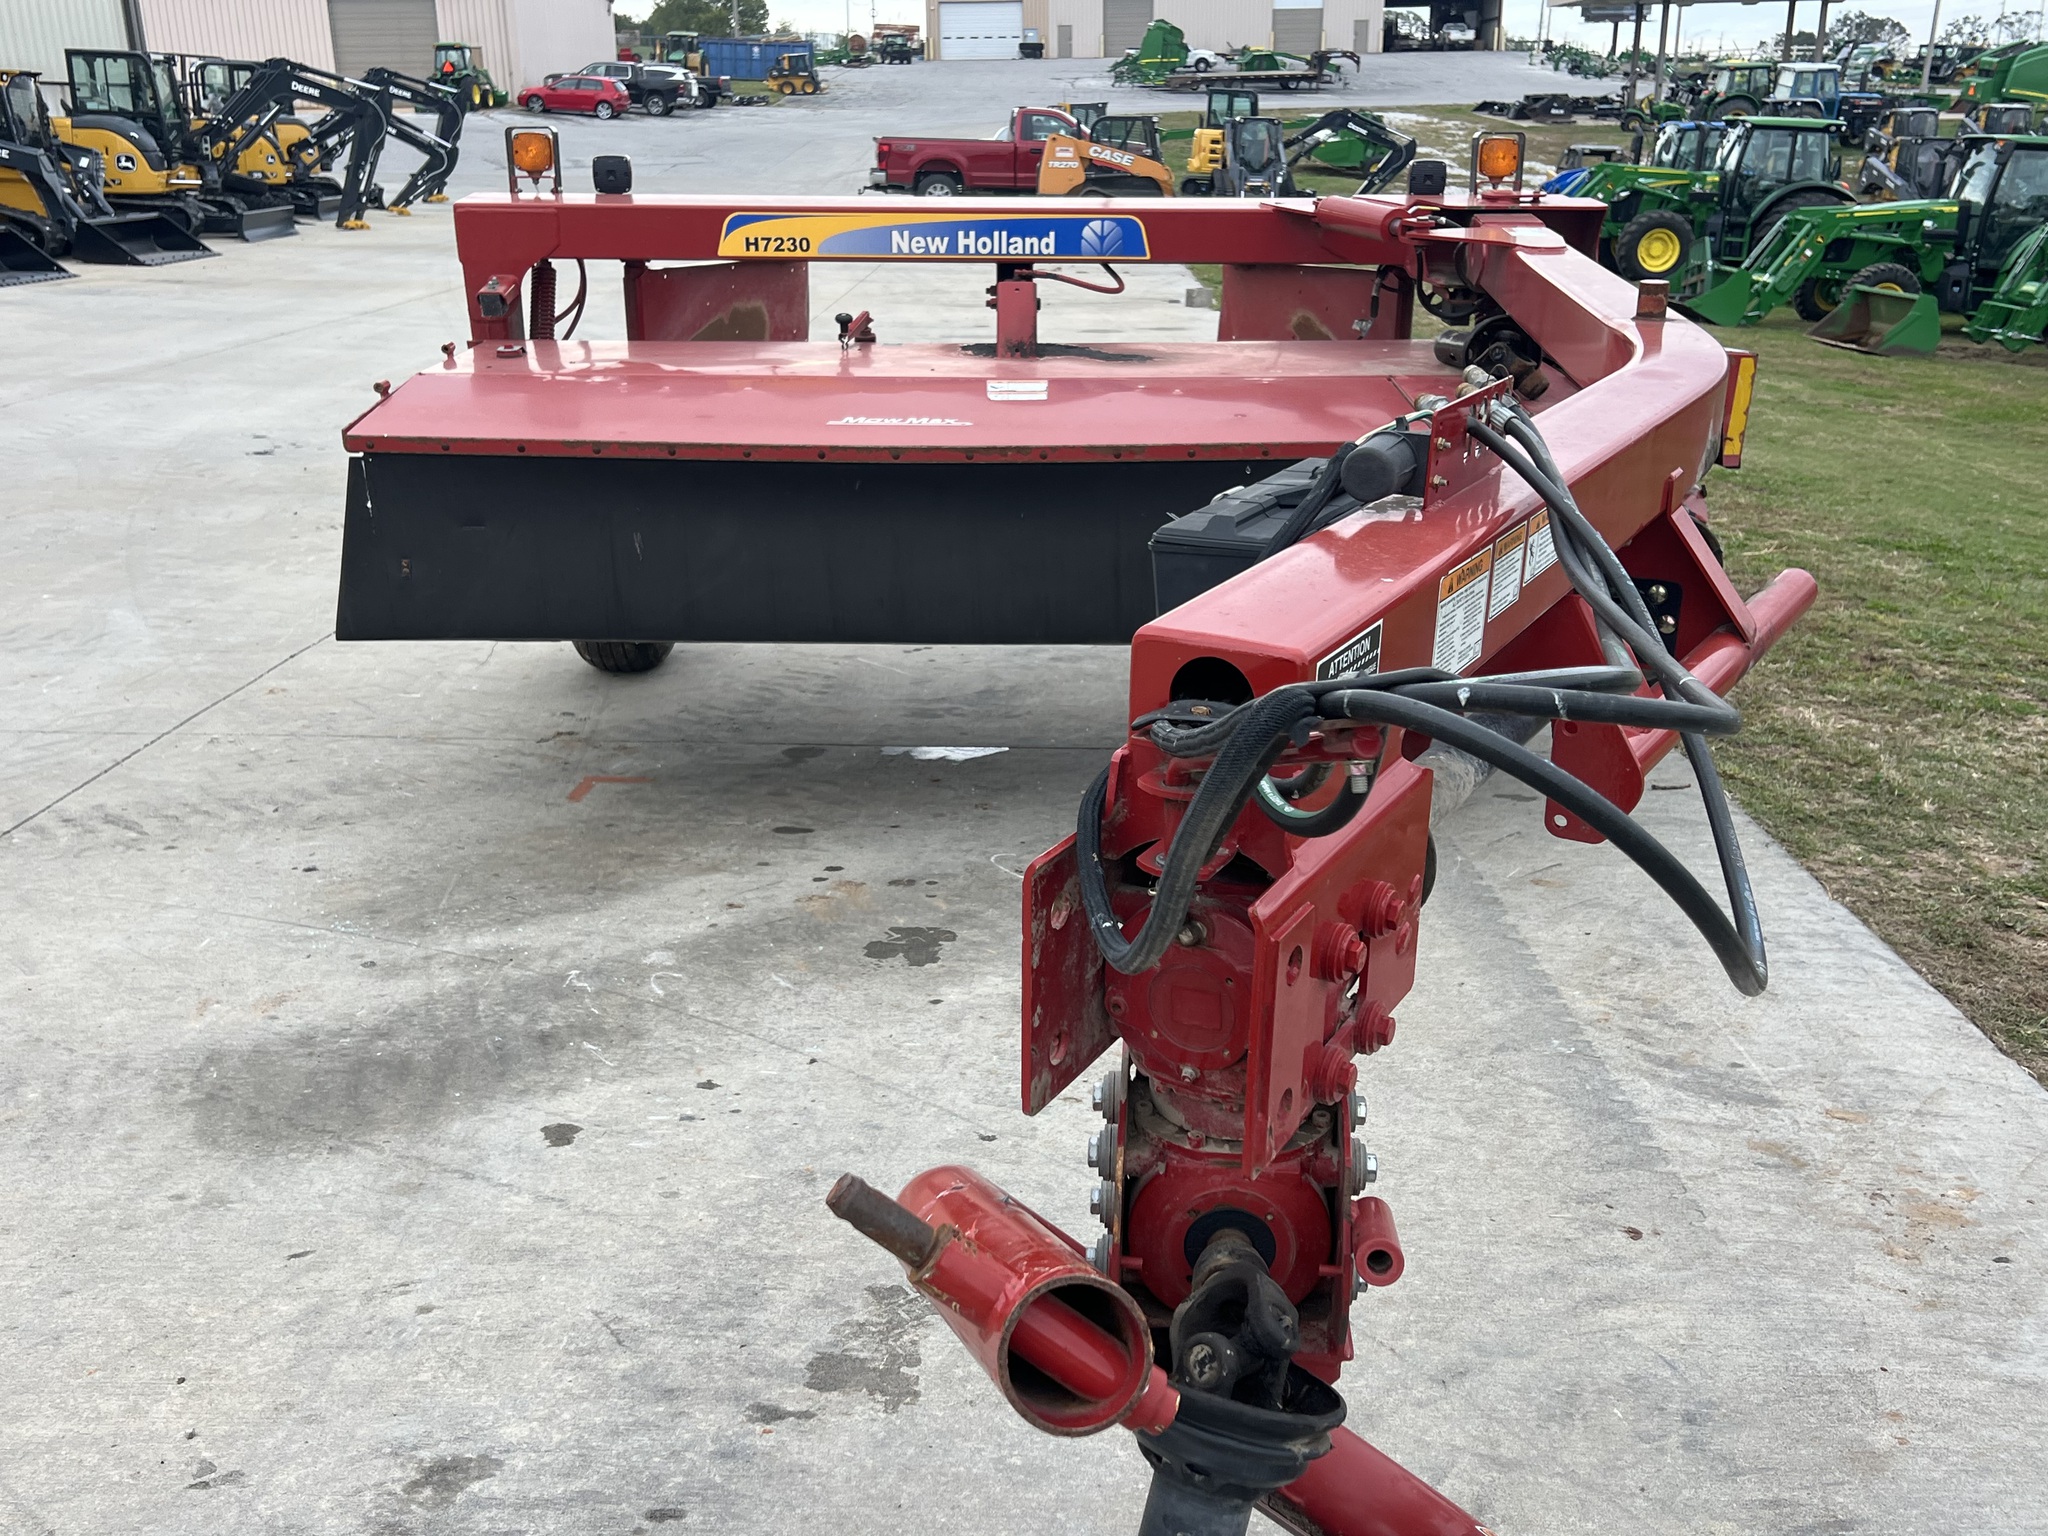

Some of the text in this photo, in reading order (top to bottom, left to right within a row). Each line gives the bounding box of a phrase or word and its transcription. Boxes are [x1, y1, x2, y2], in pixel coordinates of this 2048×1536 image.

[291, 81, 320, 98] DEERE
[388, 85, 412, 99] DEERE
[1088, 146, 1135, 166] CASE
[744, 237, 811, 253] H7230
[890, 231, 1056, 255] New Holland
[1456, 558, 1484, 587] WARNING
[1328, 636, 1371, 679] ATTENTION
